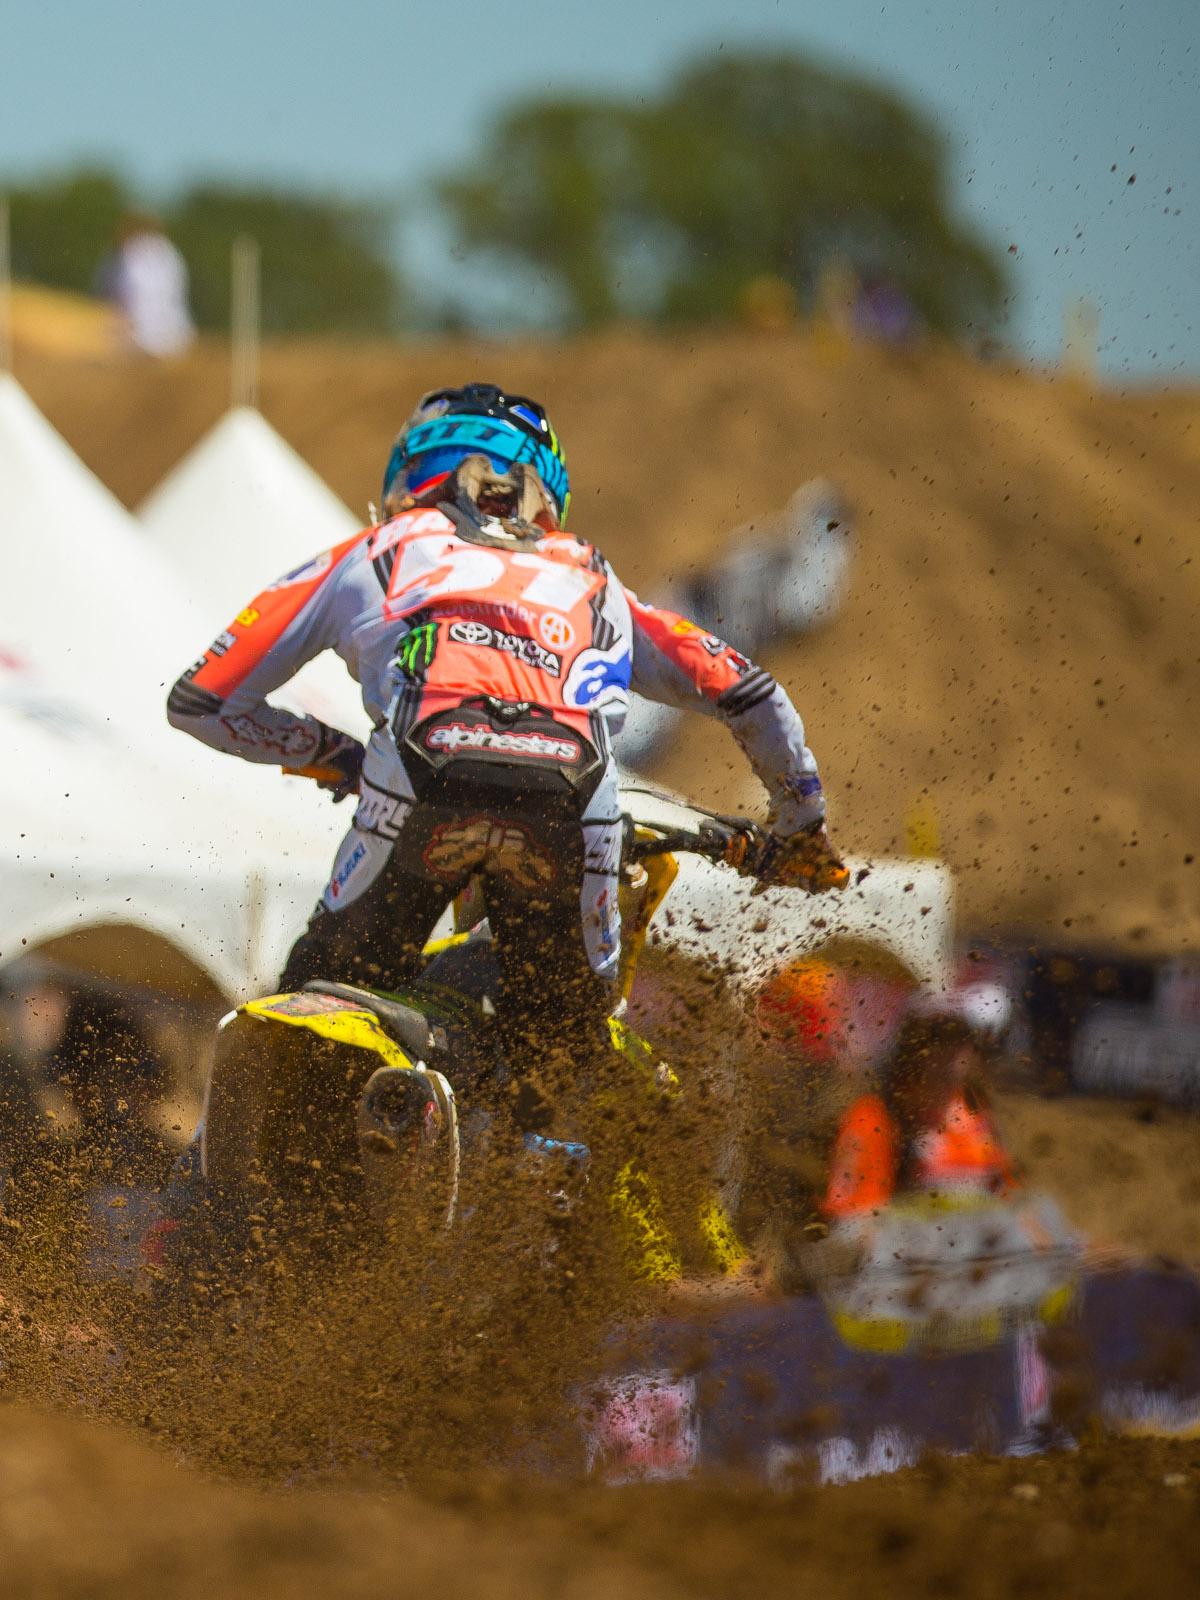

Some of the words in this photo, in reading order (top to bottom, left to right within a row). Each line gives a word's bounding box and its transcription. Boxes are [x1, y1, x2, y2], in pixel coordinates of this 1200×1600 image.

[384, 535, 601, 618] 51
[494, 629, 560, 672] TOYOTA
[427, 725, 578, 760] alpinestars
